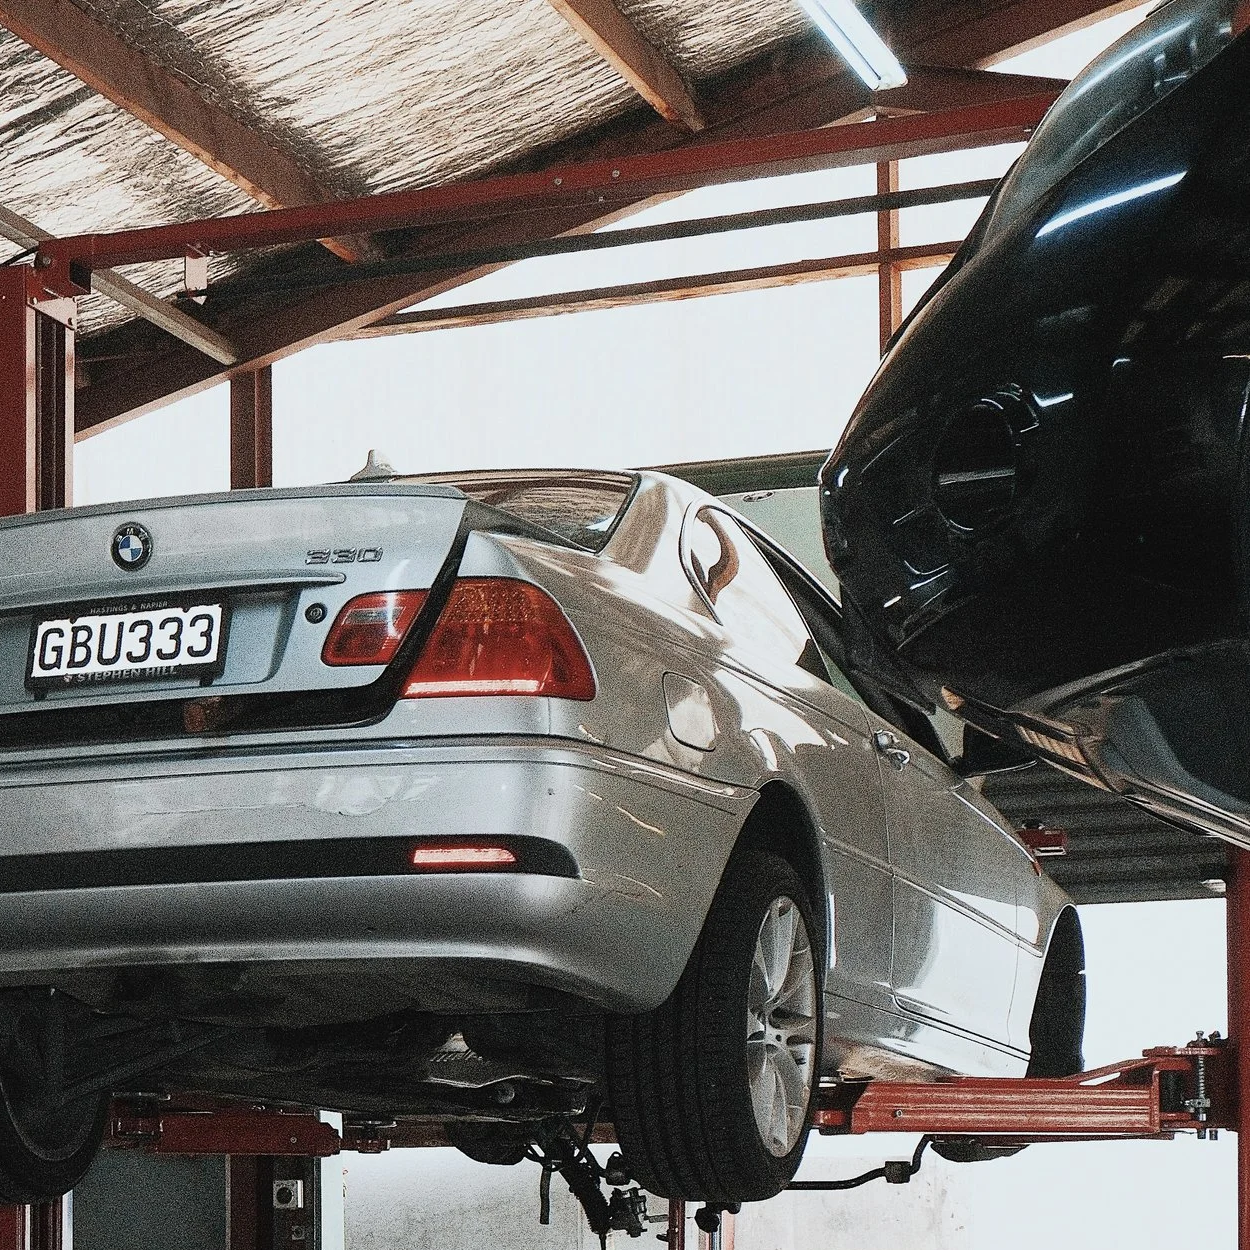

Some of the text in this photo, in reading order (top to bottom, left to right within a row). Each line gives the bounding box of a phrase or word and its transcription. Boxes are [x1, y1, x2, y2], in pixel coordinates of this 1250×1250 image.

[305, 547, 383, 565] 330
[90, 604, 128, 614] HASTINGS
[140, 601, 168, 610] NAPIER
[38, 614, 215, 671] GBU333
[77, 666, 177, 682] STEPHEN HILL
